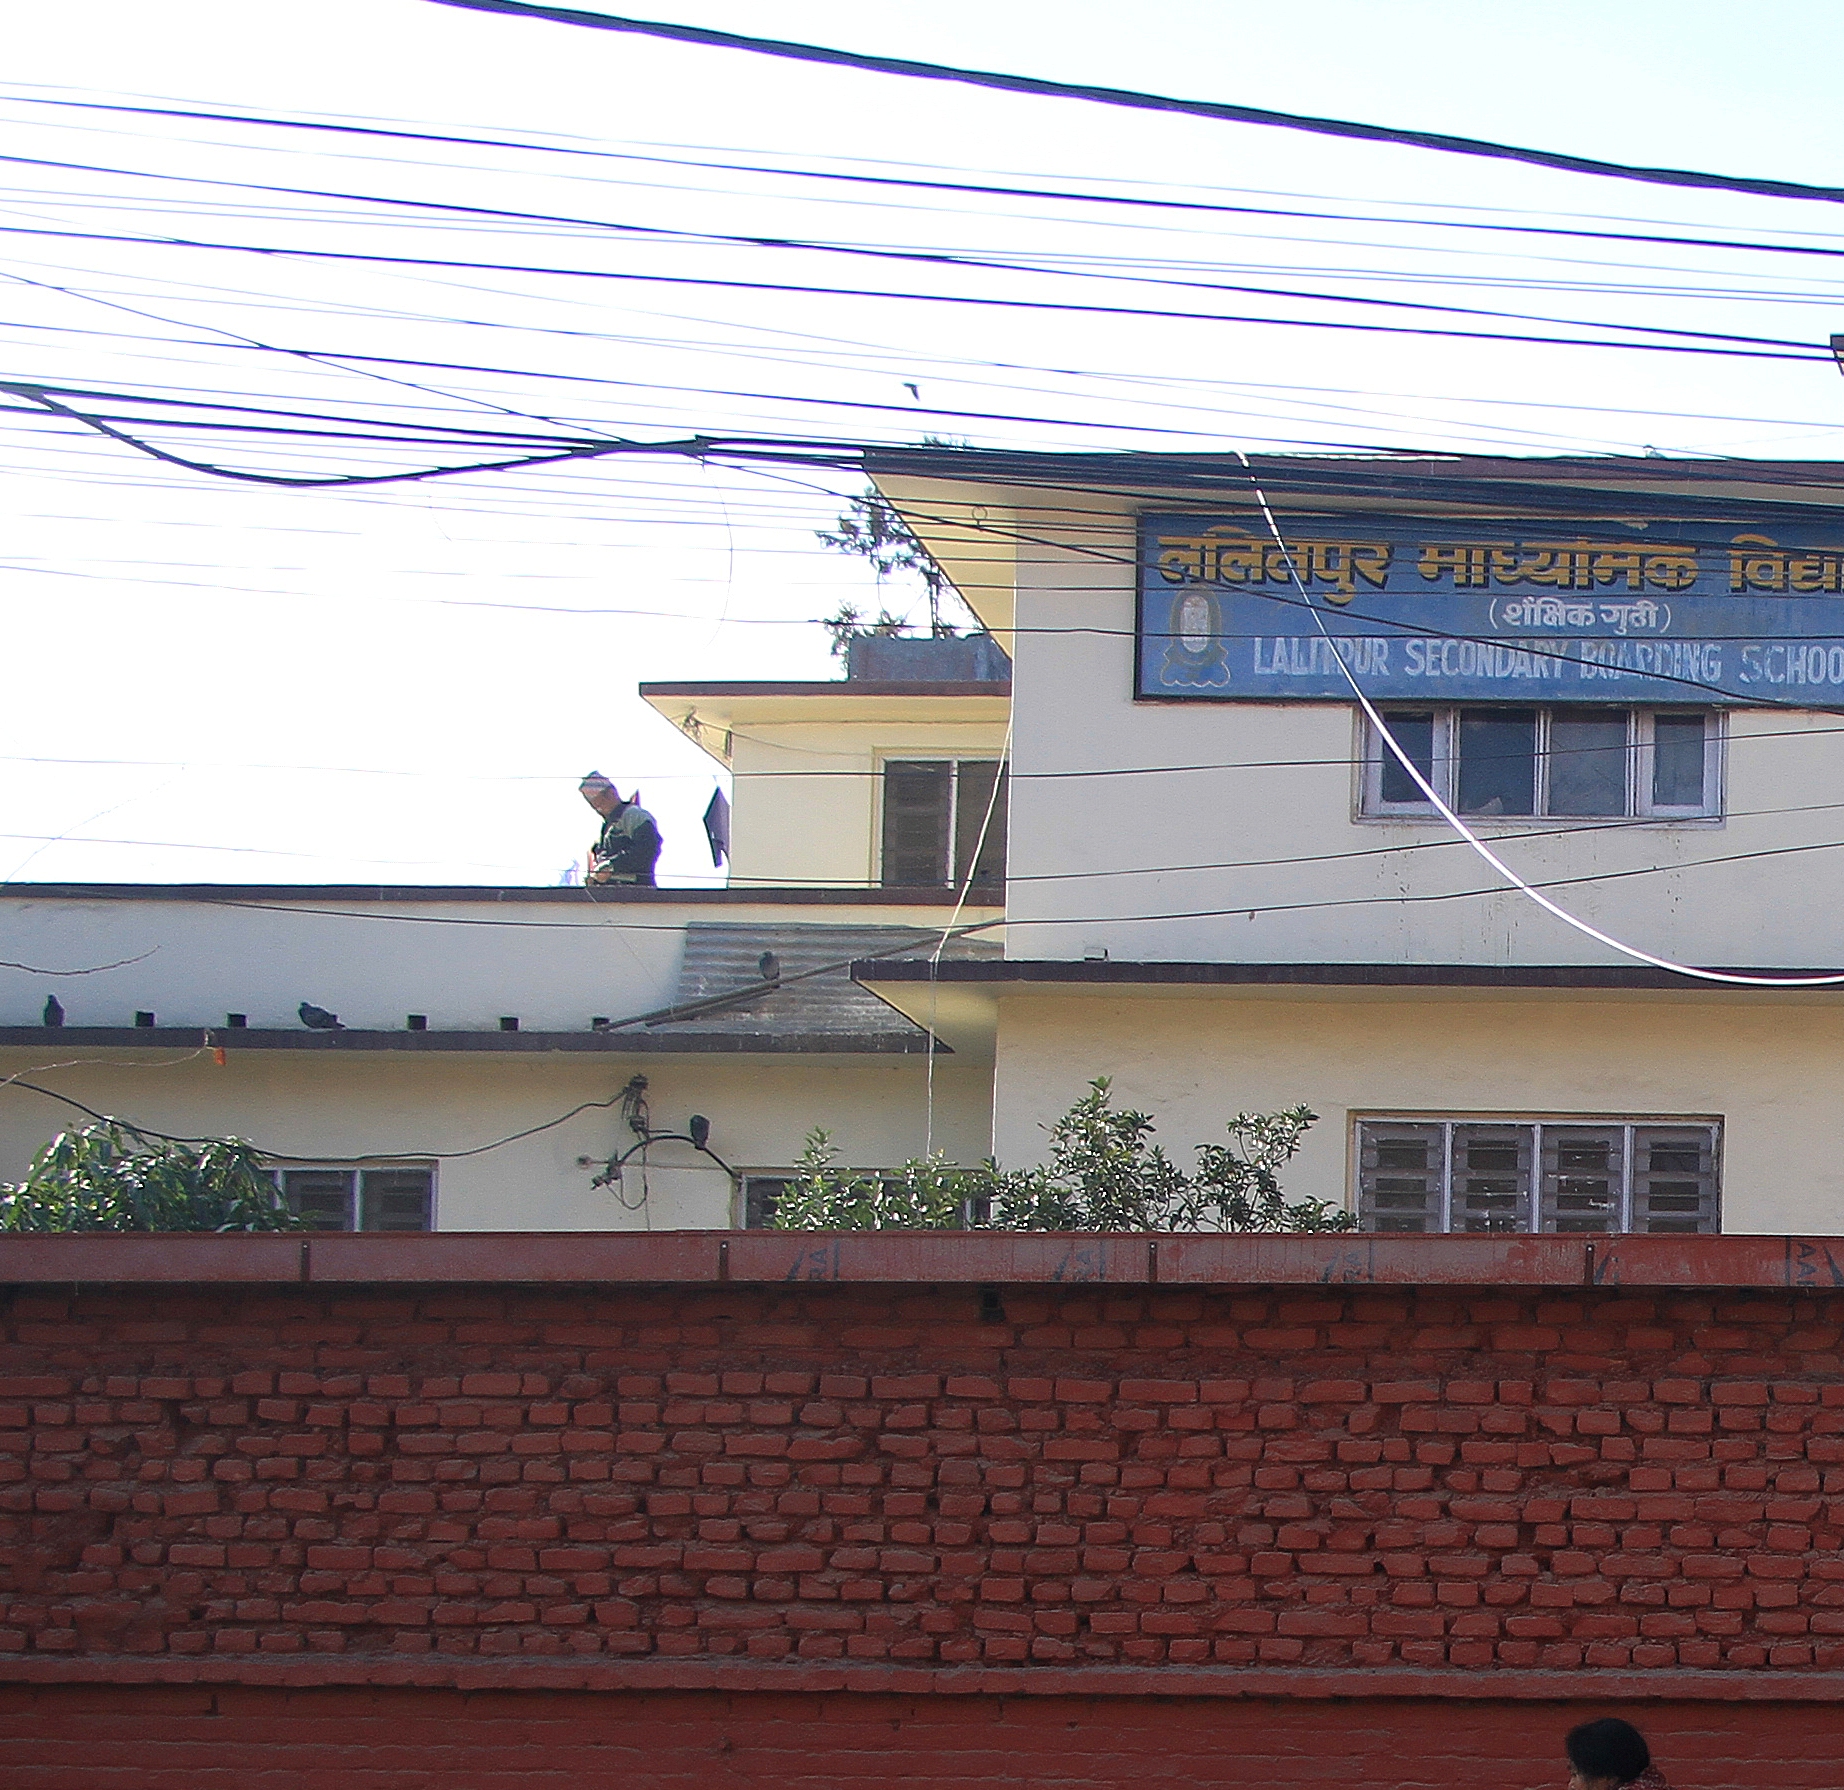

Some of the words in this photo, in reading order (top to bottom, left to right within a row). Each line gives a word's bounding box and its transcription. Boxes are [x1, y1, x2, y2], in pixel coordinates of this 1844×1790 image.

[1254, 637, 1390, 676] LALITPUR
[1404, 638, 1568, 678] SECONDARY
[1579, 641, 1722, 682] BOARDING
